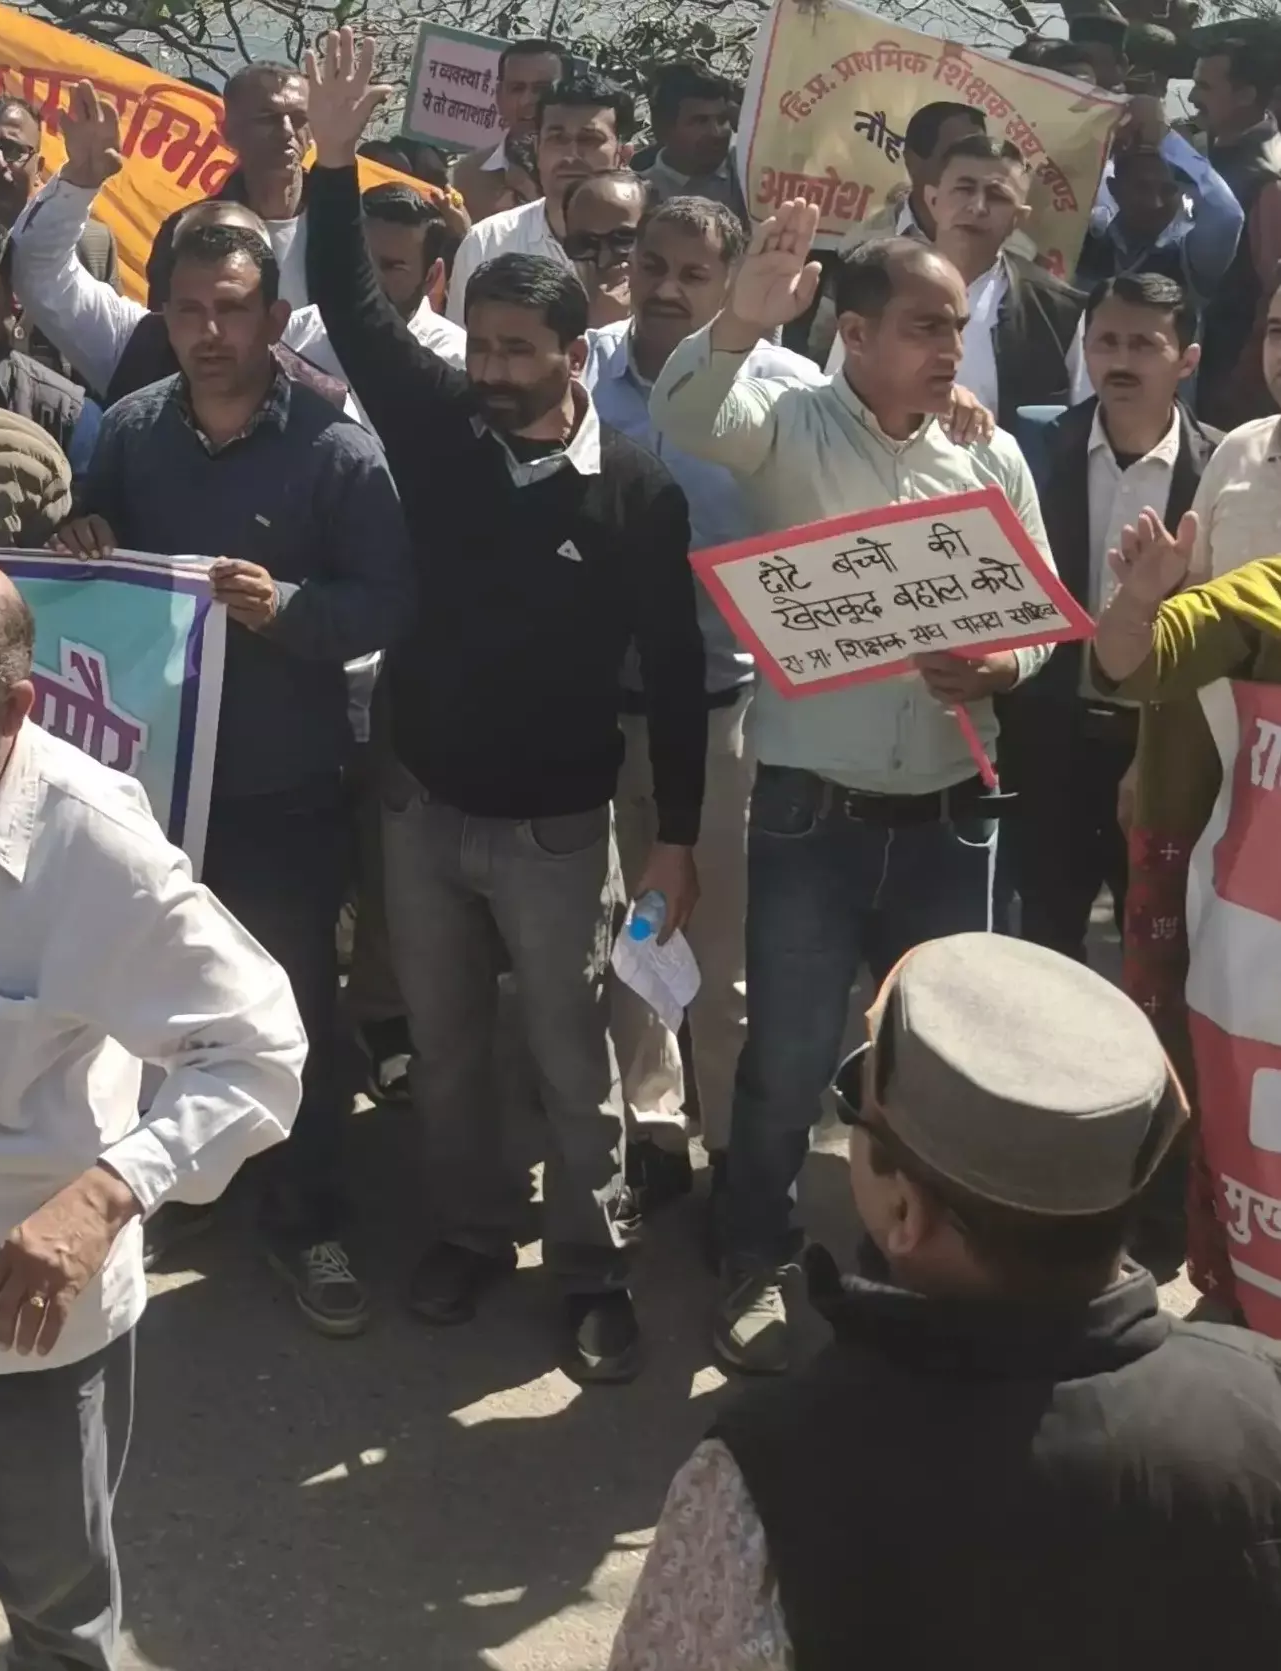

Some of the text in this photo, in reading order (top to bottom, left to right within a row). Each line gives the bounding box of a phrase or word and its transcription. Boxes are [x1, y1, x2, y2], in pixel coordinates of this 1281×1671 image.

[831, 40, 934, 82] प्राथमिक
[933, 52, 1016, 119] शिक्षक
[1005, 113, 1046, 158] संघ
[758, 555, 812, 594] छोटे
[927, 522, 971, 560] की
[893, 574, 969, 611] बहाल
[971, 557, 1025, 594] करो
